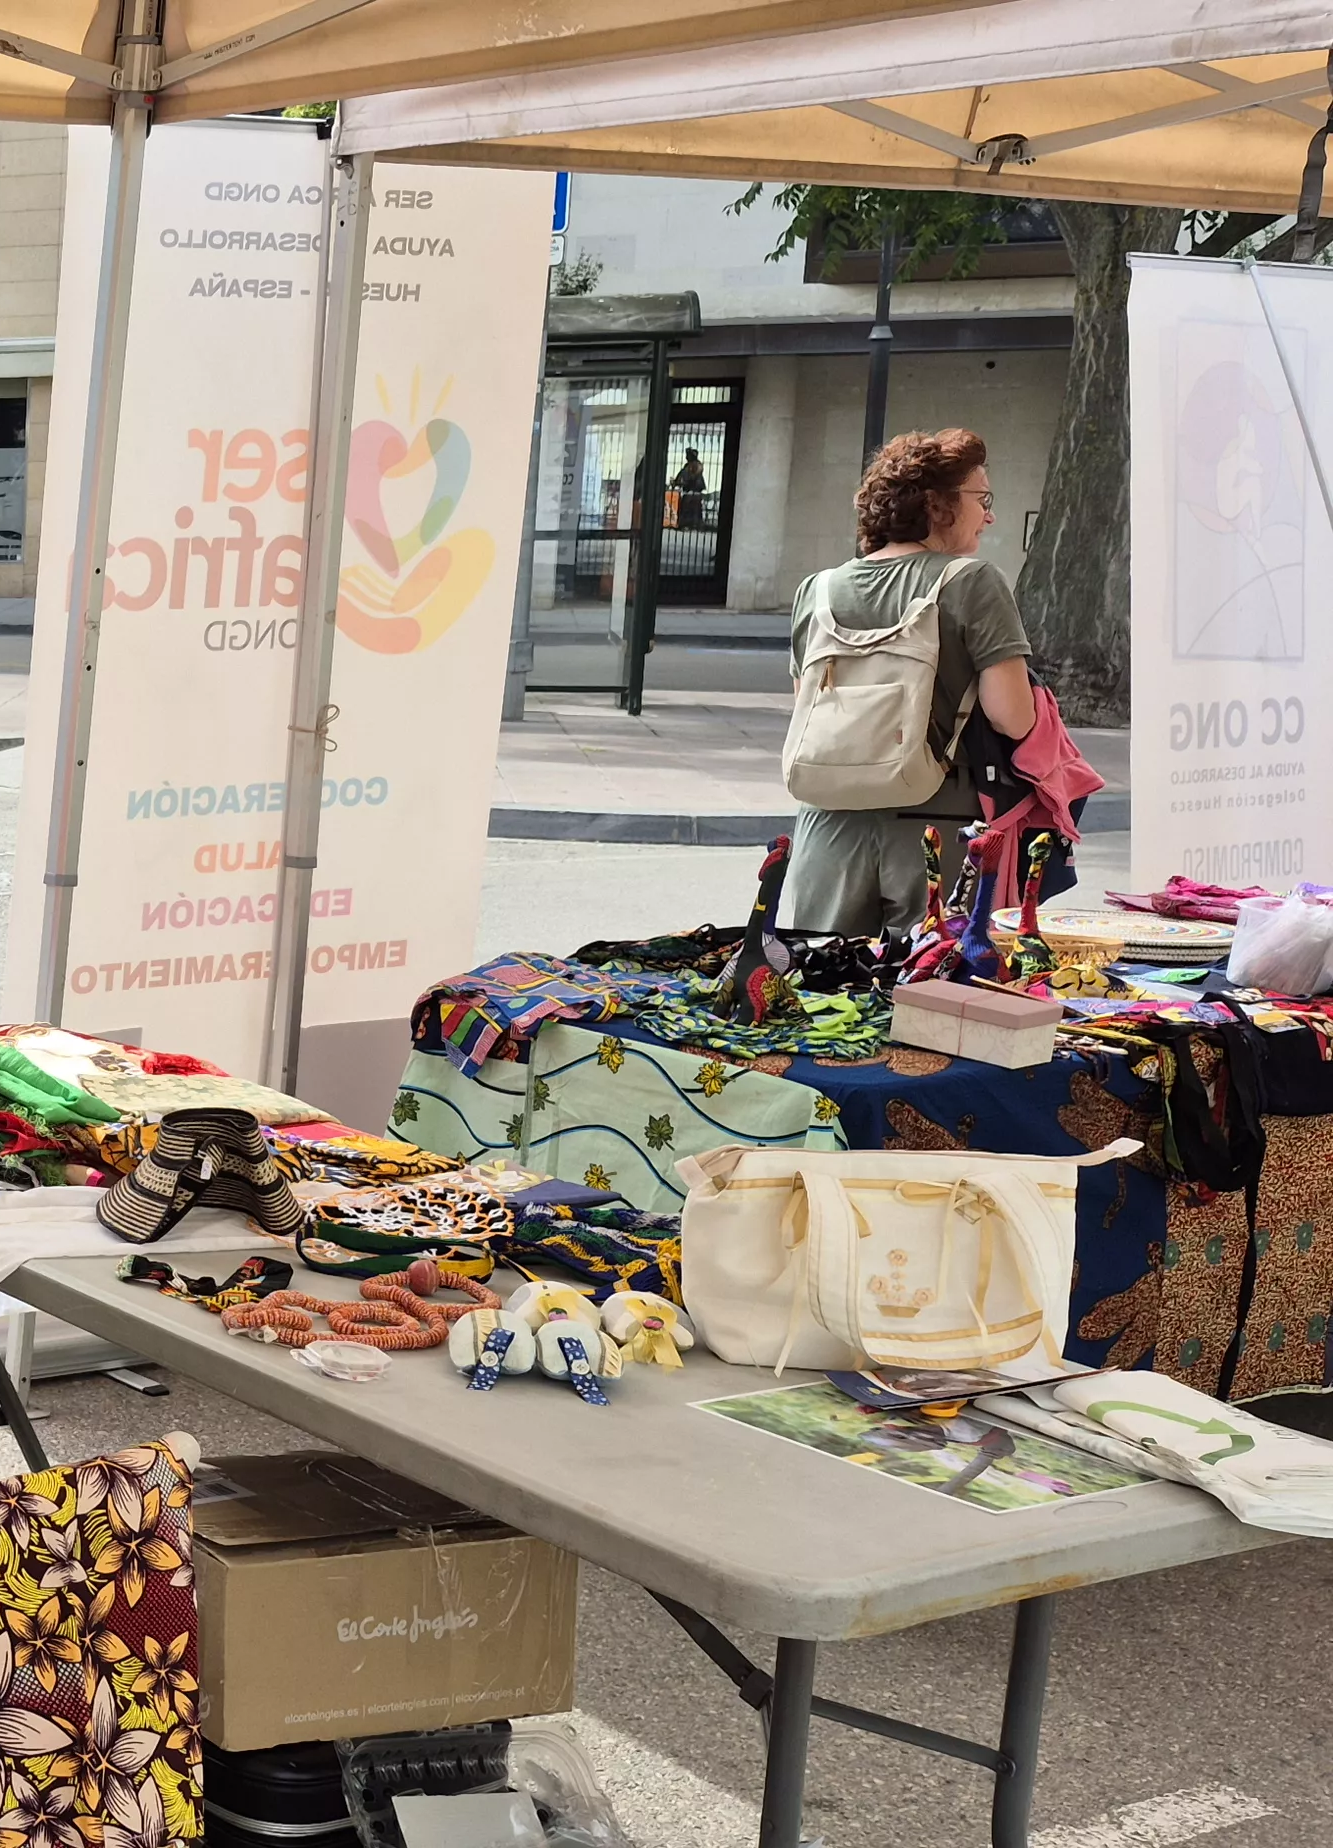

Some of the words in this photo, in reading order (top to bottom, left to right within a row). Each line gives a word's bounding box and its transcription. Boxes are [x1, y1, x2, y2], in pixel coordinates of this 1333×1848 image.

[337, 1617, 359, 1642] El
[359, 1615, 407, 1640] Corte
[408, 1605, 479, 1643] Inglés
[284, 1708, 359, 1724] elcorteingles.es
[367, 1696, 450, 1716] elcorteingles.com
[454, 1685, 525, 1706] elcorteingles.pt
